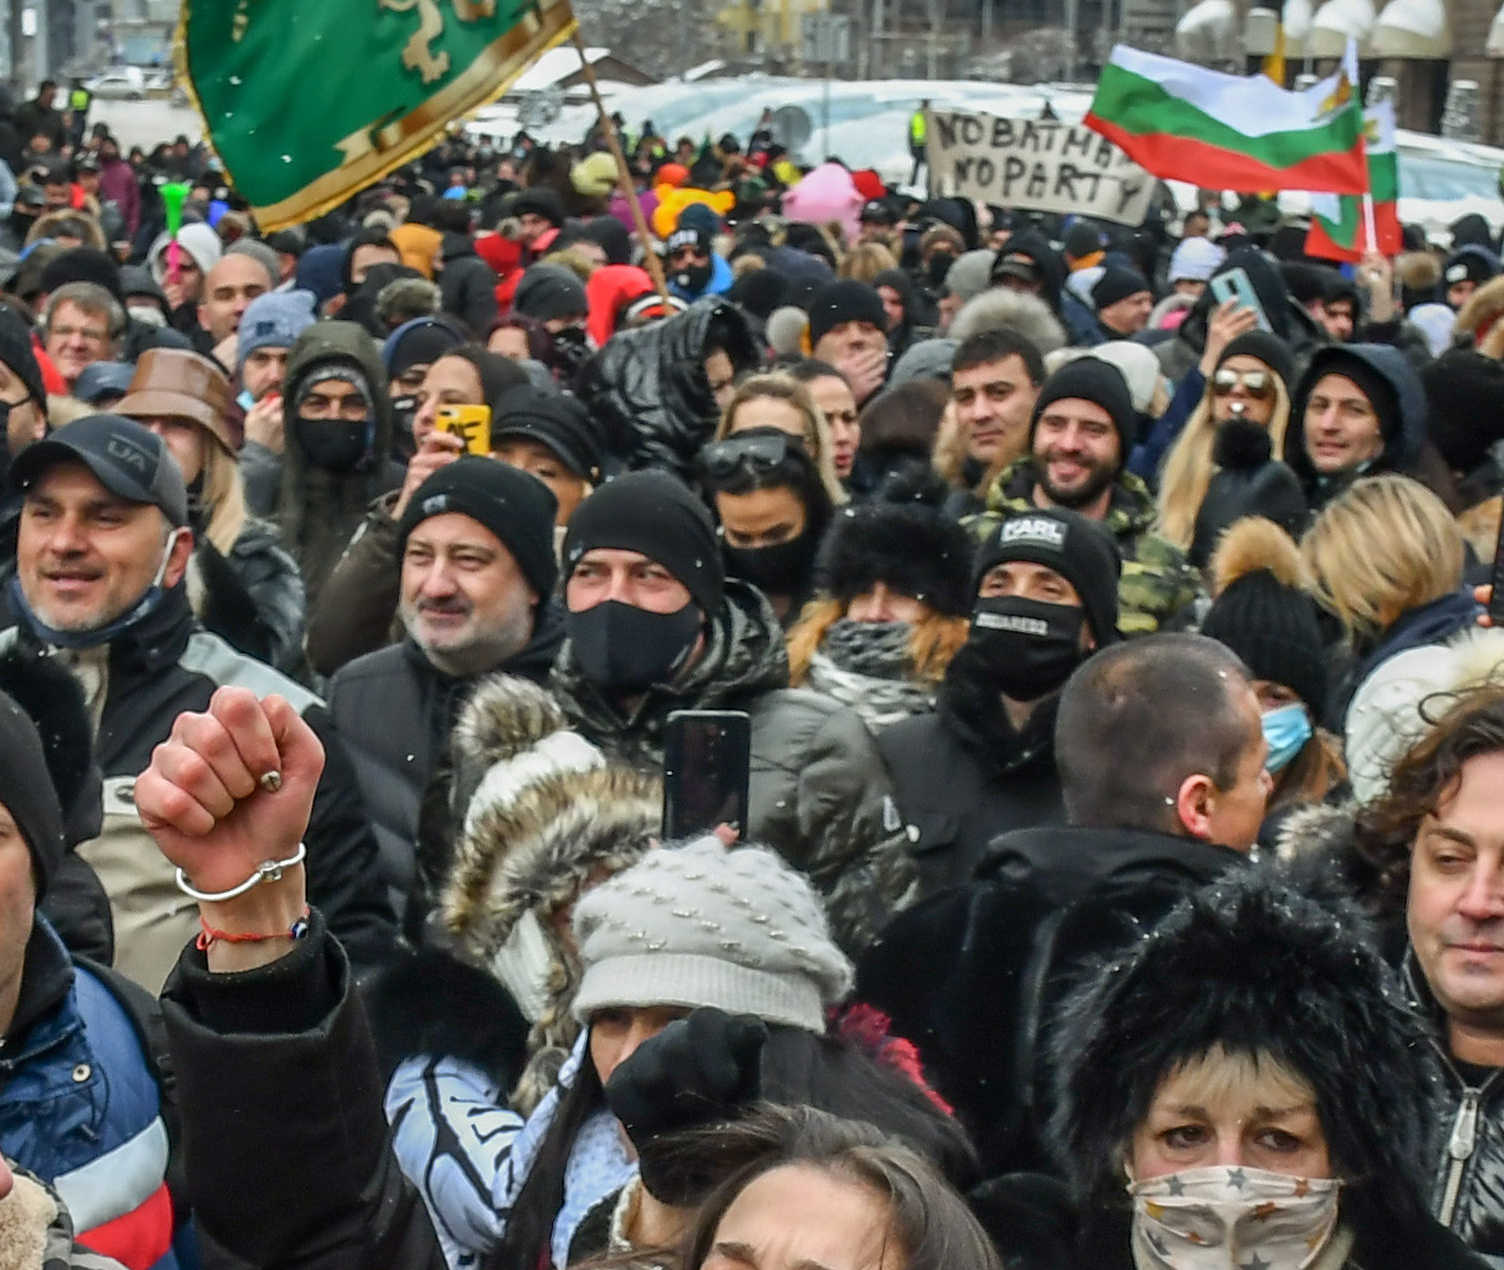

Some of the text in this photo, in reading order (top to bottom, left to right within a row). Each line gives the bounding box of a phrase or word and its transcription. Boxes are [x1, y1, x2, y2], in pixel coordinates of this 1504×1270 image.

[935, 114, 1134, 168] NO BATMA
[955, 156, 1141, 214] NO PARTY
[107, 439, 146, 474] UA
